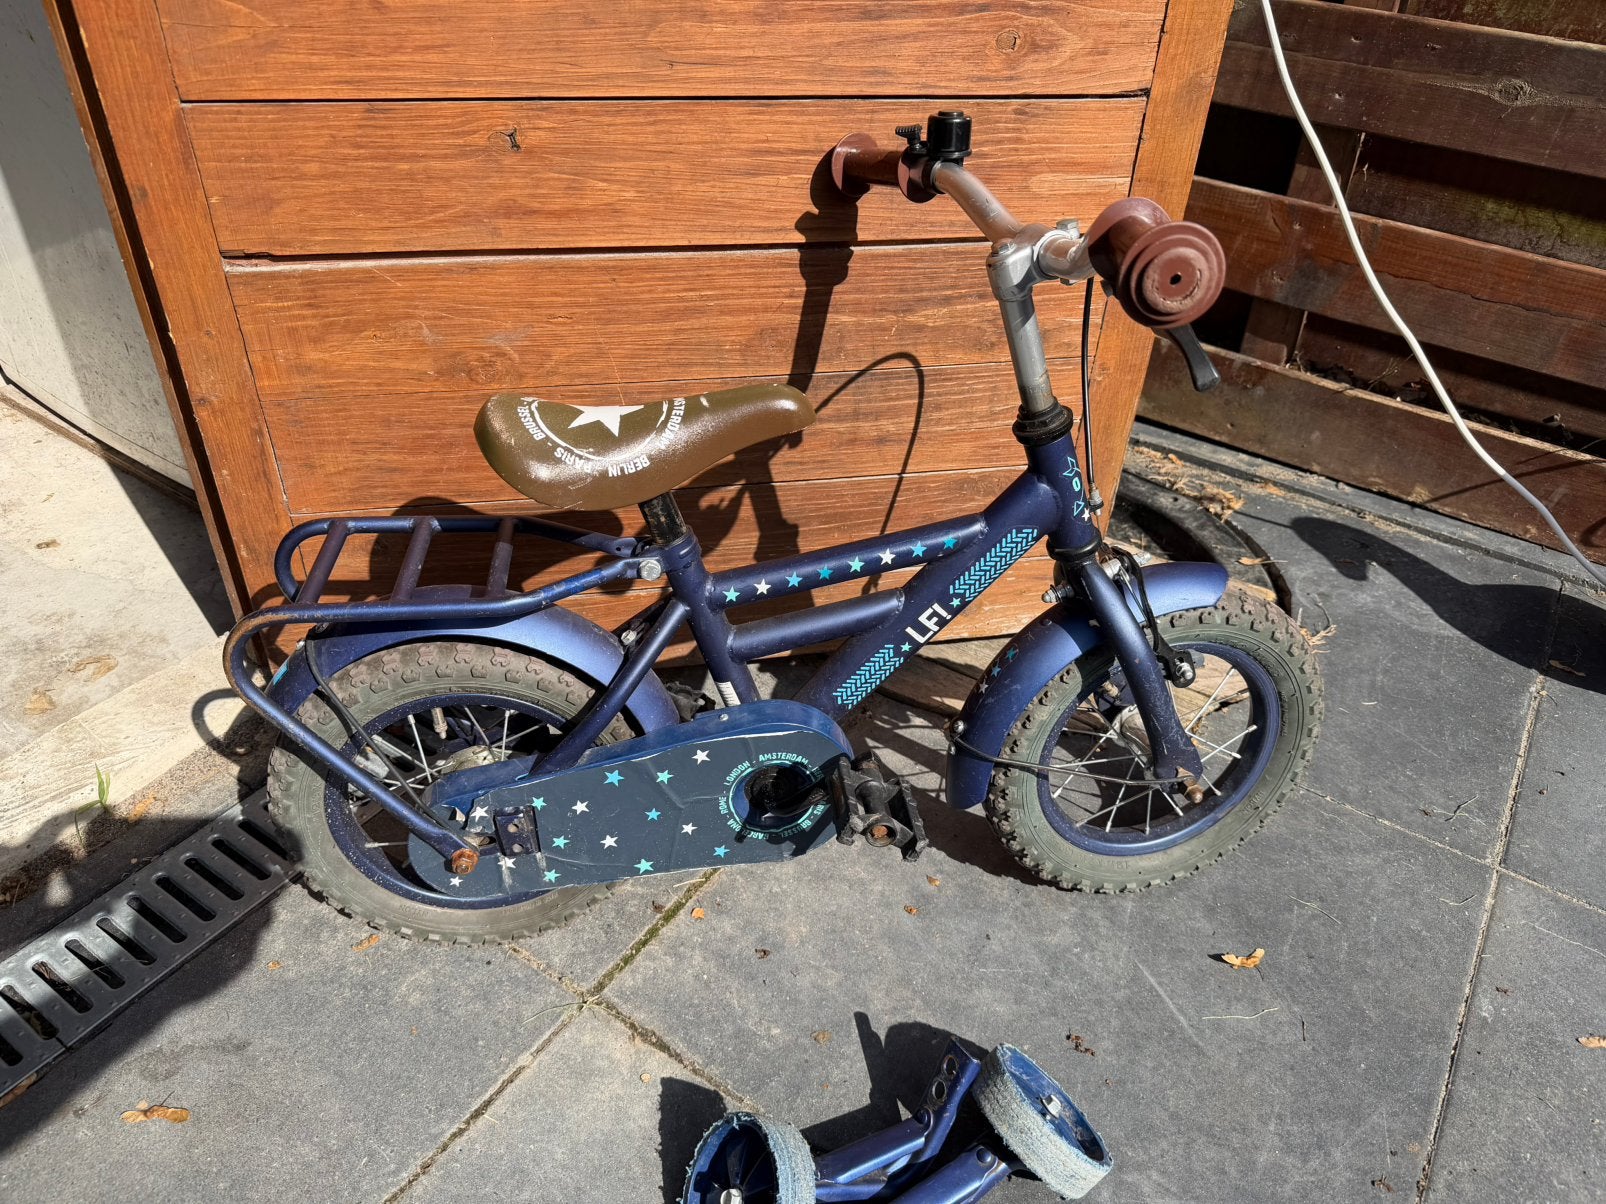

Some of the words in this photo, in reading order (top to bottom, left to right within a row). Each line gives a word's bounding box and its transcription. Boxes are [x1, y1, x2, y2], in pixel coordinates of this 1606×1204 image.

[517, 405, 546, 441] BRUSSEL
[554, 446, 593, 473] PARIS
[607, 454, 650, 477] BERLIN
[758, 752, 809, 766] AMSTERDAM
[723, 760, 751, 786] LONDON
[718, 796, 729, 815] ROME
[726, 818, 769, 840] BARCELONA
[779, 819, 812, 838] BRUSSEL
